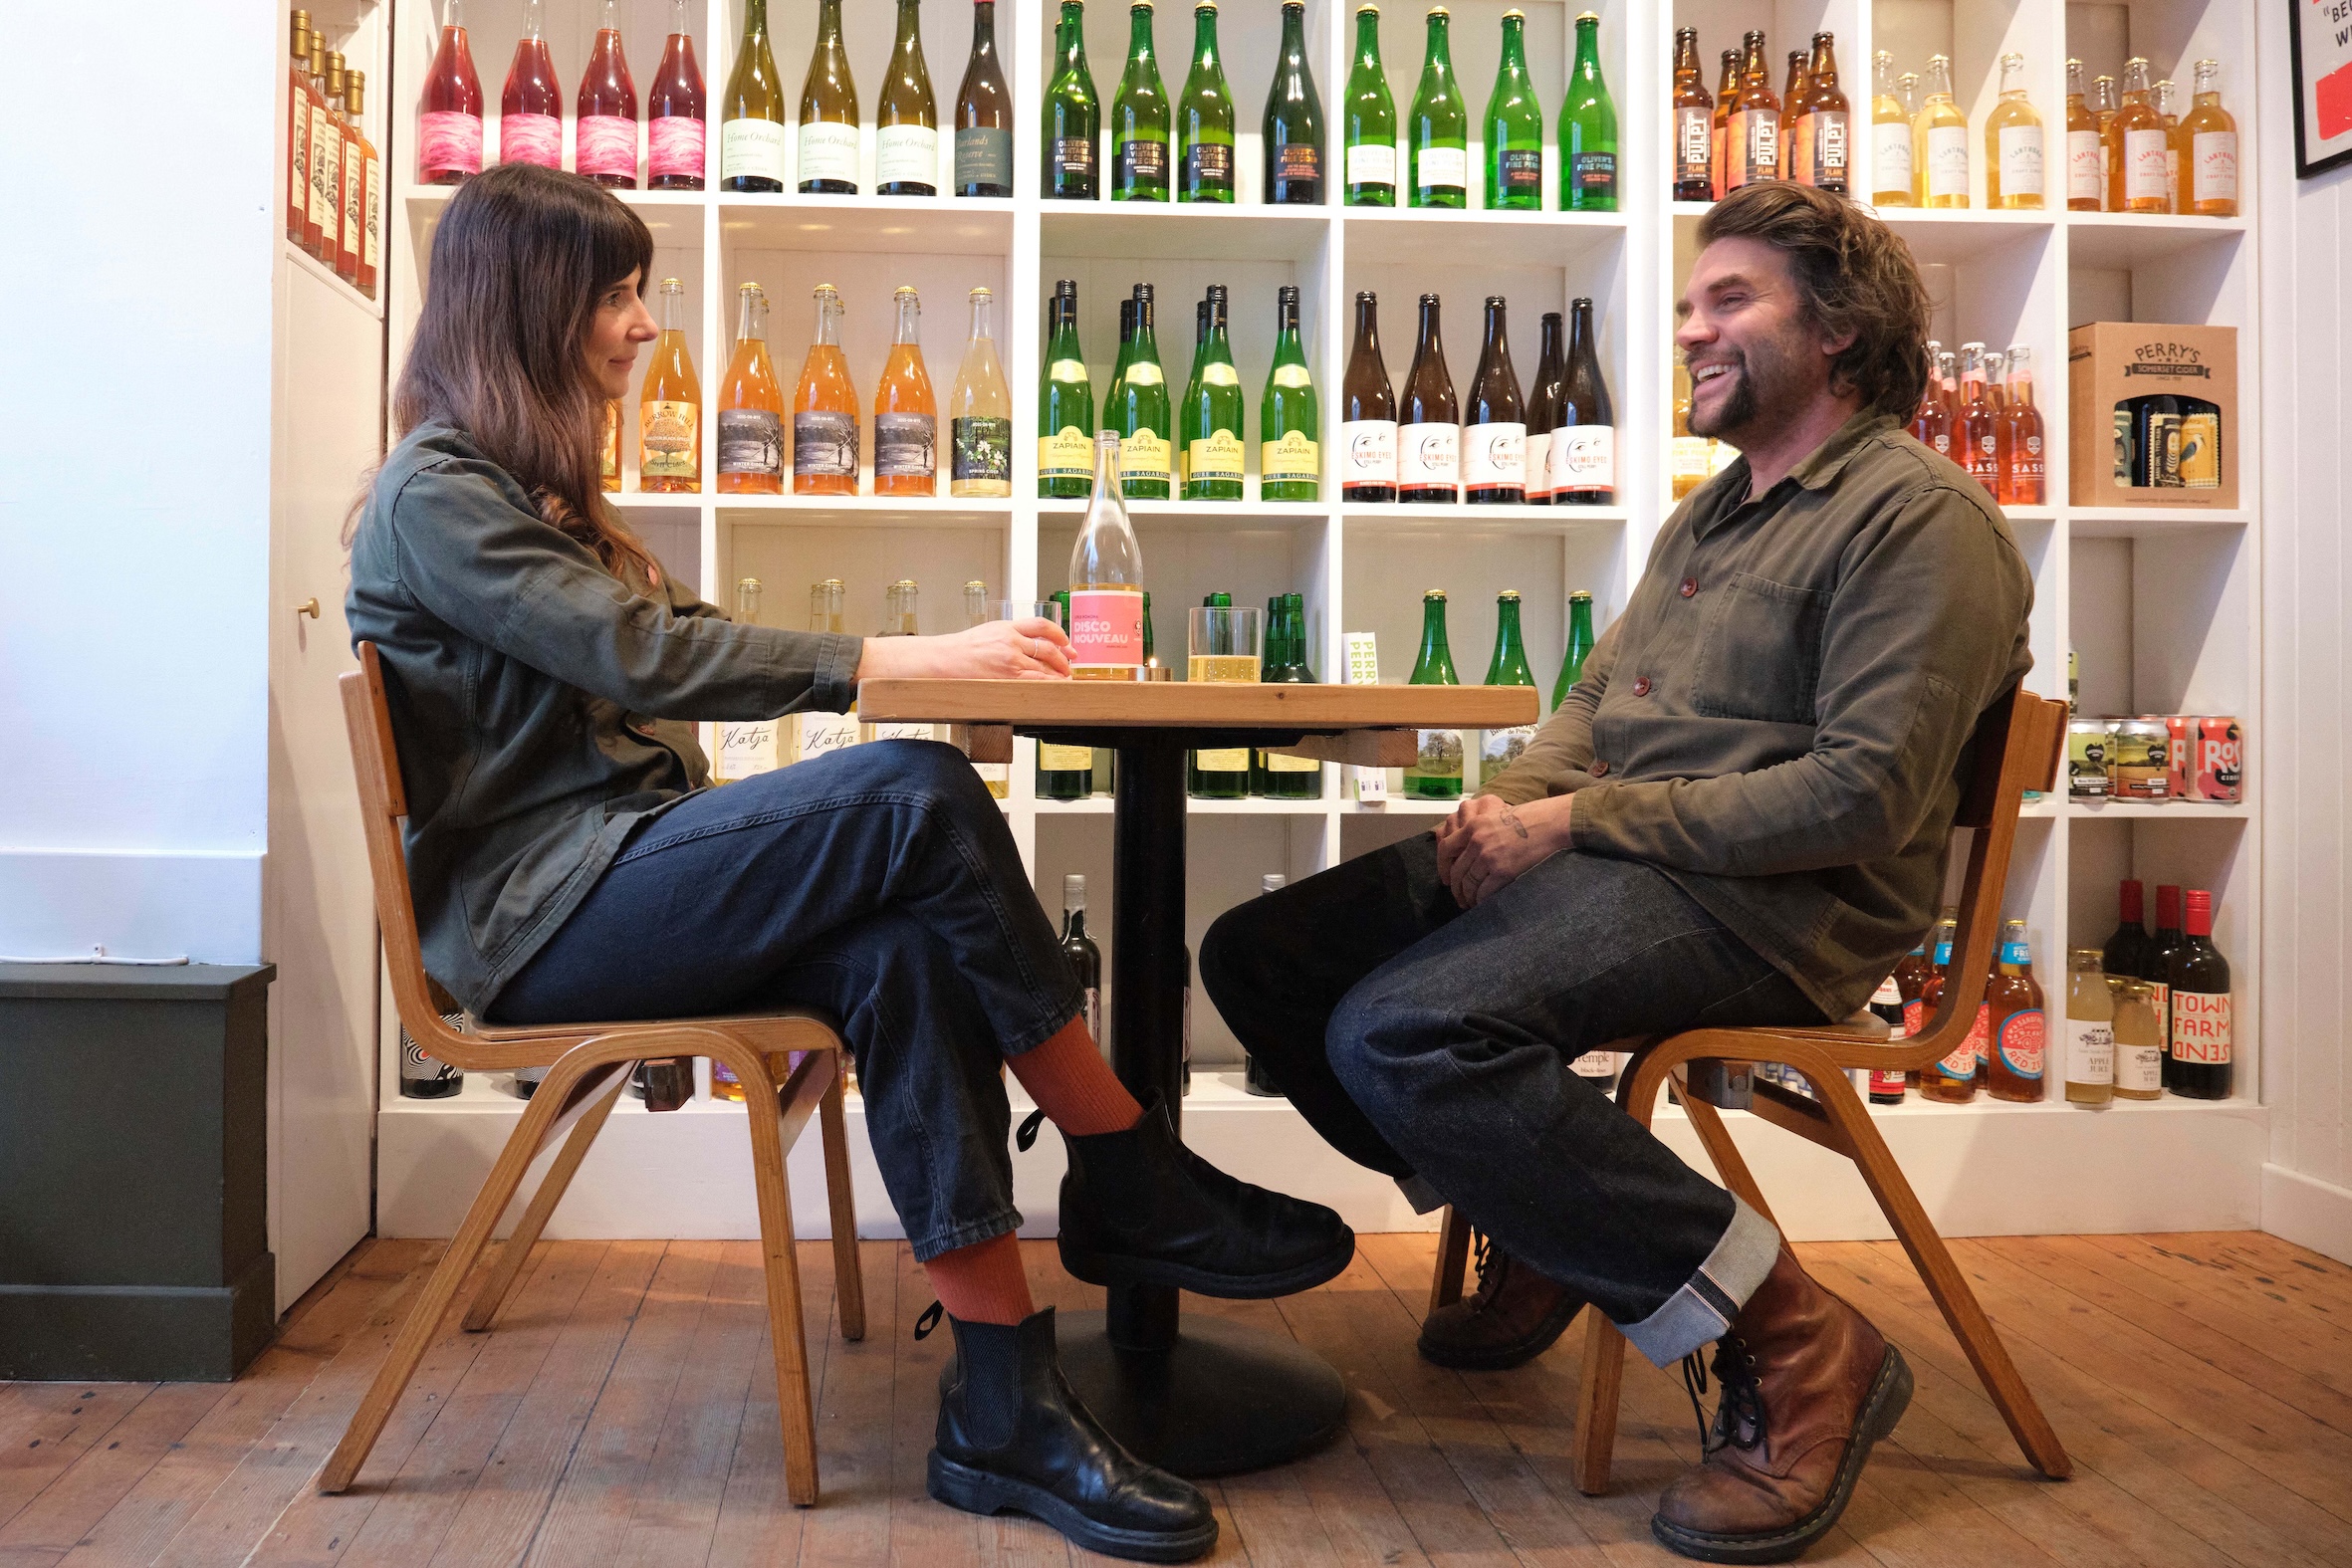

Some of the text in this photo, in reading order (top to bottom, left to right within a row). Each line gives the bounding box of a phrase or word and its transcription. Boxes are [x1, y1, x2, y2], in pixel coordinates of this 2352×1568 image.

[2323, 0, 2352, 23] "BE
[2335, 25, 2352, 47] W
[727, 131, 748, 143] Home
[805, 135, 825, 146] Home
[882, 138, 903, 149] Home
[2135, 342, 2201, 363] PERRY'S
[2137, 364, 2175, 373] SOMERSET
[644, 410, 677, 428] BURROW
[1073, 620, 1111, 633] DISCO
[1073, 633, 1128, 644] NOUVEAU
[720, 727, 772, 750] Katja
[805, 728, 856, 750] Katja
[2174, 994, 2231, 1013] TOWN
[2175, 1016, 2231, 1038] FARM
[2008, 1050, 2028, 1068] RED
